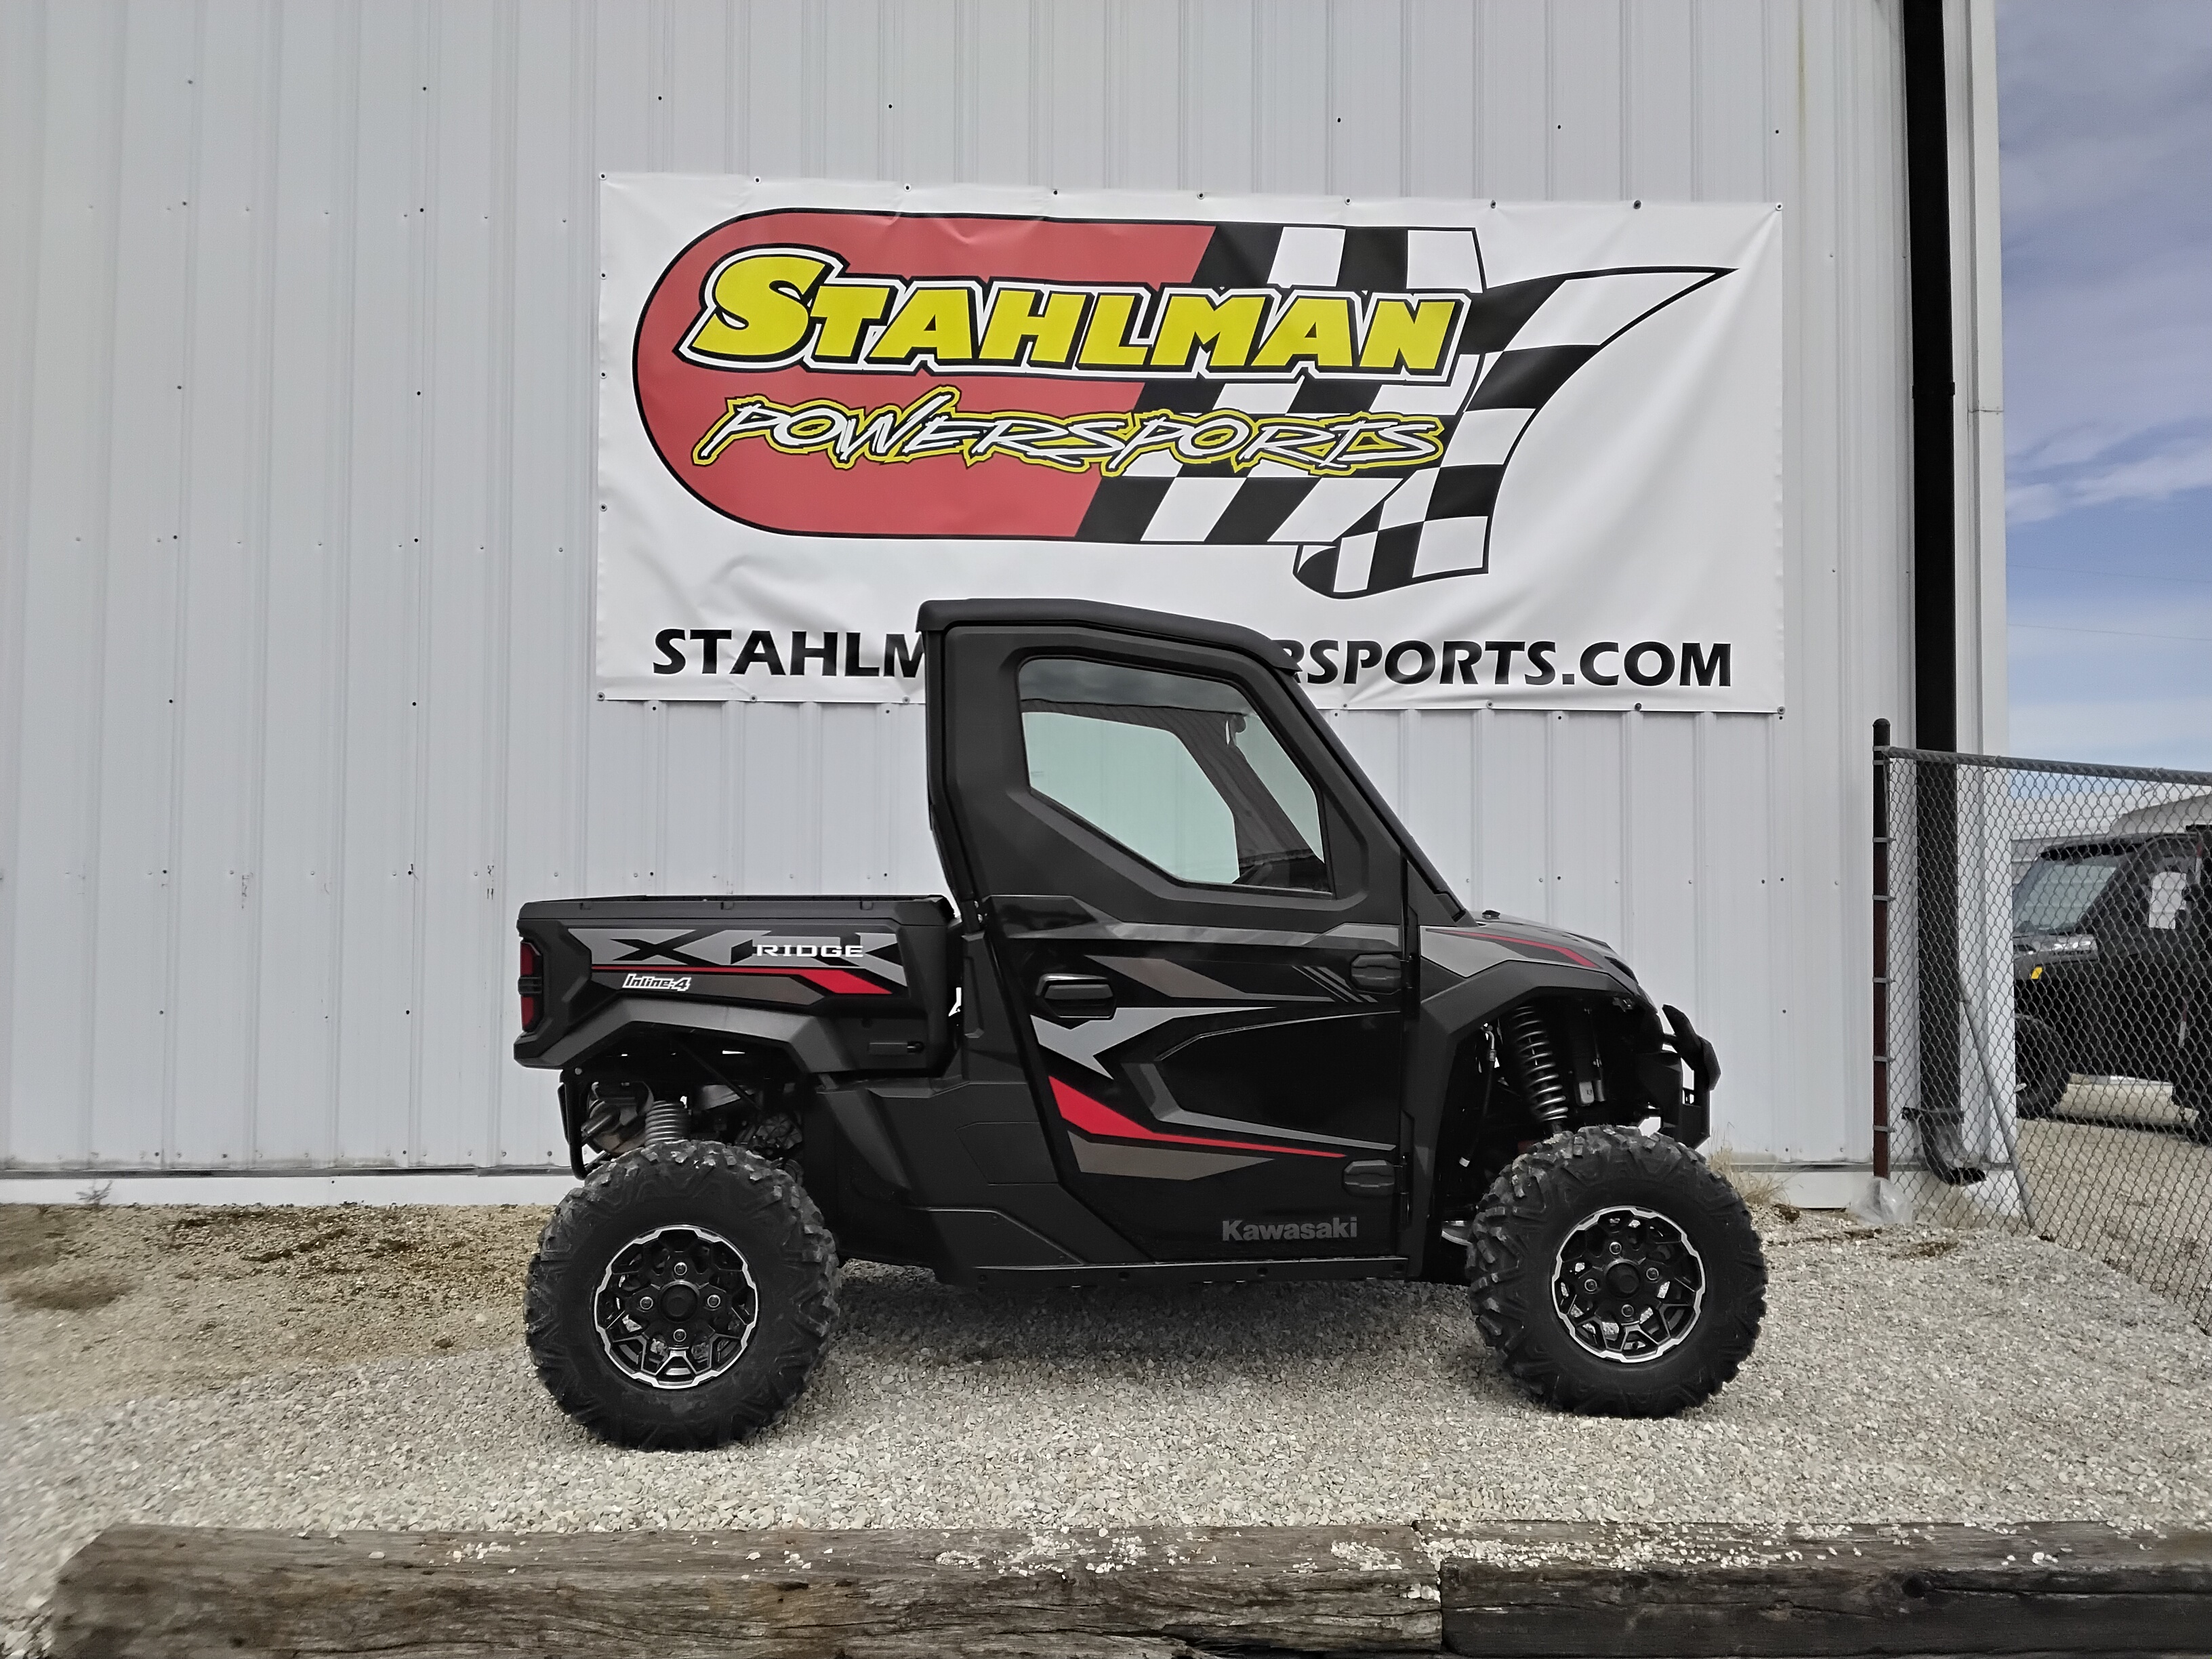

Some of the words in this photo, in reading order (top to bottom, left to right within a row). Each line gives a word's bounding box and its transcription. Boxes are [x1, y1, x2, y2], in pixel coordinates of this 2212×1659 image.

[681, 248, 1471, 381] STAHLMAN
[693, 386, 1444, 474] POWERSPORTS
[757, 945, 863, 958] RIDGE
[1223, 1217, 1357, 1241] Kawasaki
